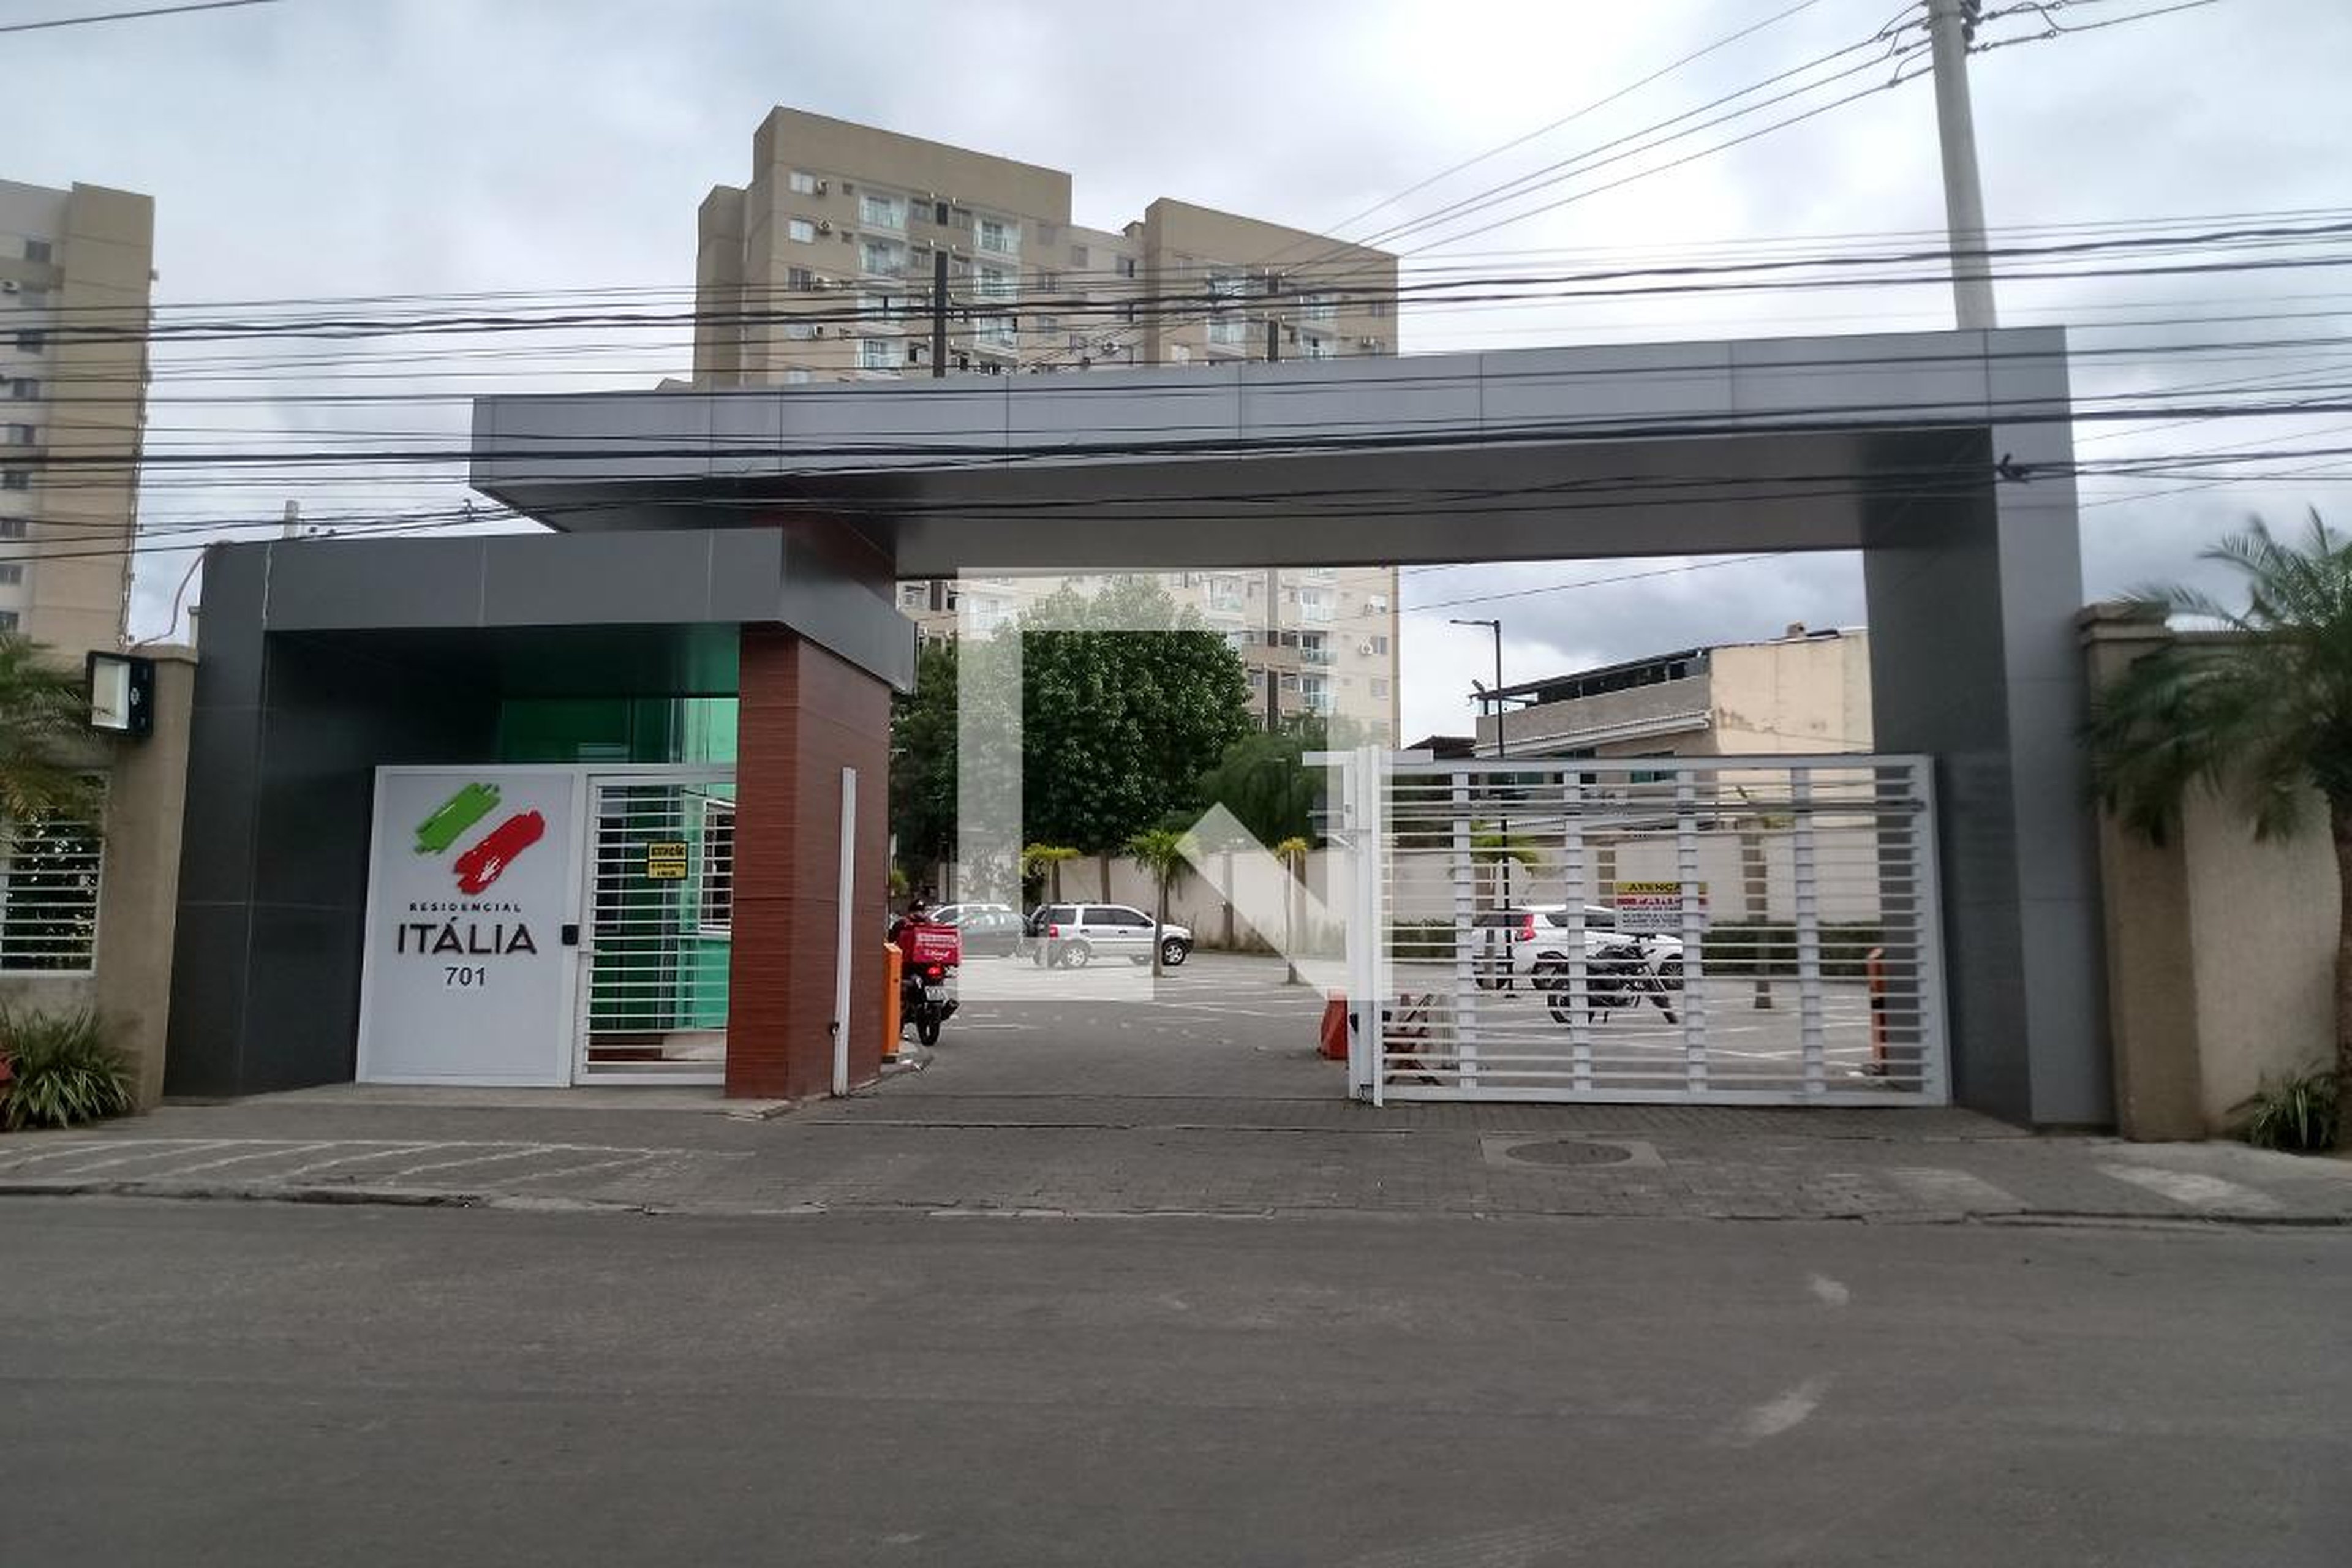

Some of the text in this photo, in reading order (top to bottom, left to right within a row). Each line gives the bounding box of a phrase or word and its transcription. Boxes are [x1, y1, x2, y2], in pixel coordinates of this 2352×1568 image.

[409, 902, 521, 912] RESIDENCIAL
[397, 916, 537, 954] ITÁLIA
[445, 966, 485, 986] 701
